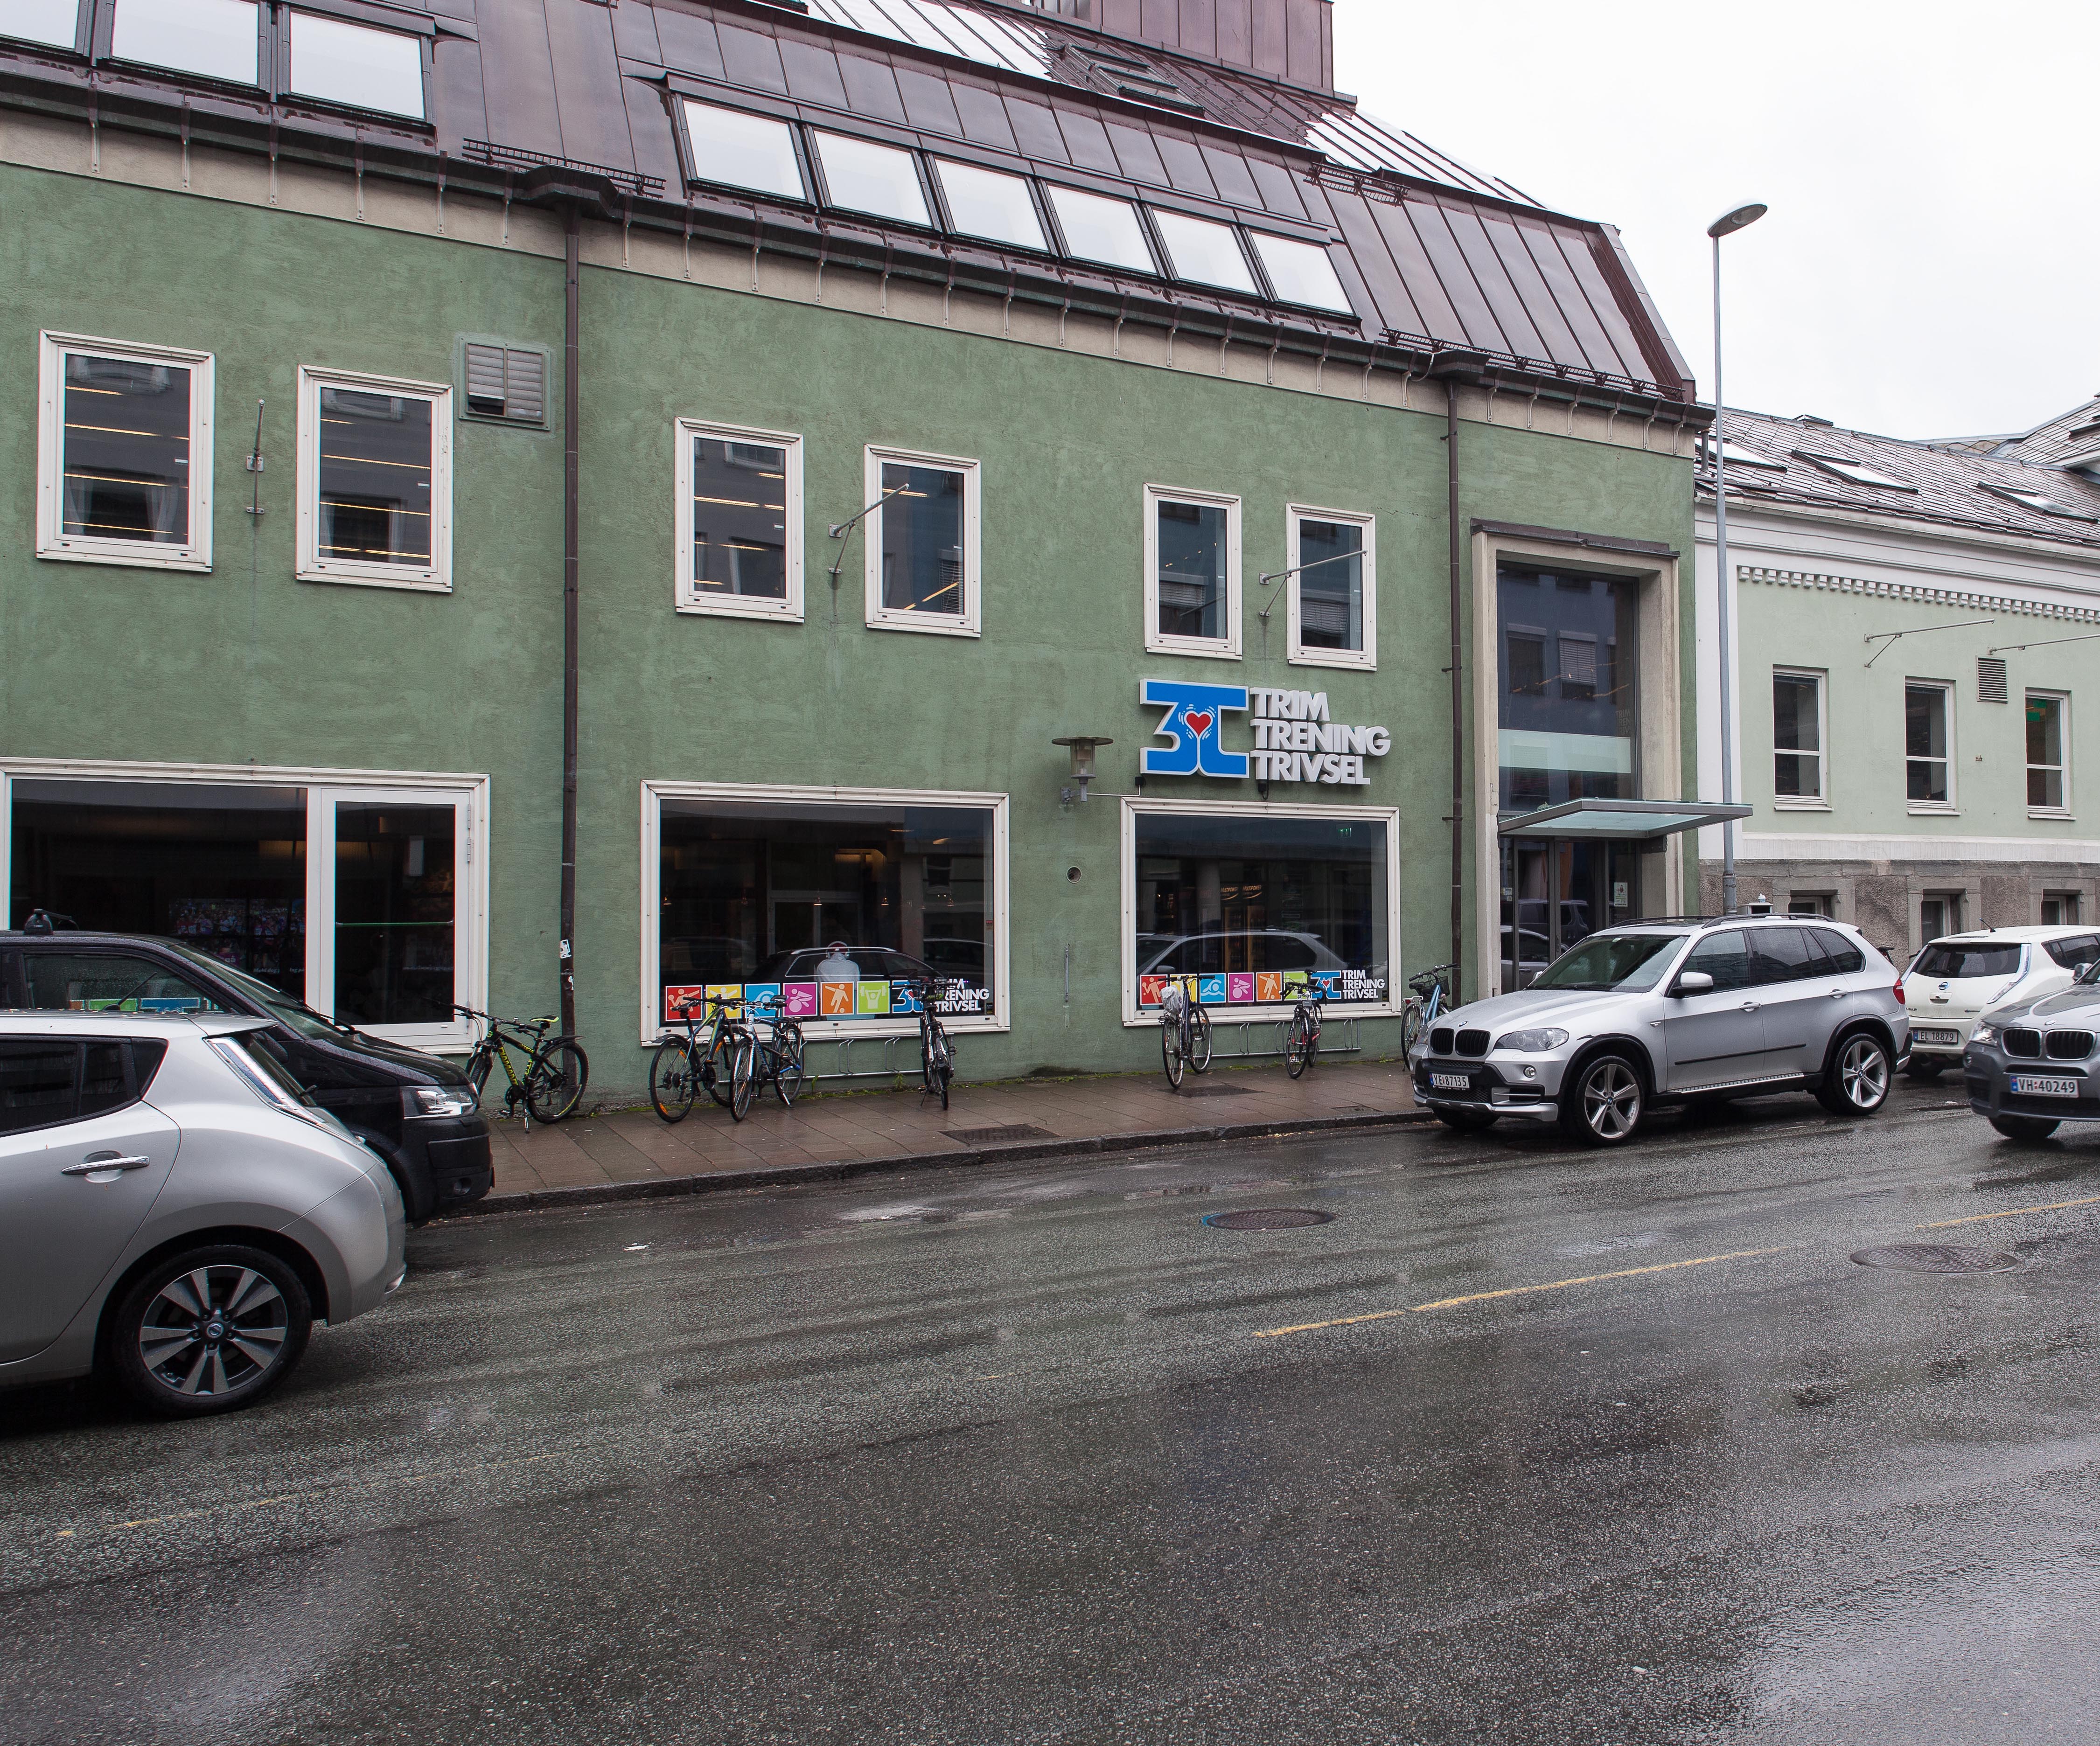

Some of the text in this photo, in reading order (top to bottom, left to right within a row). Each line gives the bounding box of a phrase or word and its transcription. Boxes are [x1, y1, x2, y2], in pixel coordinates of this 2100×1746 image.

[1249, 687, 1330, 721] TRIM
[1250, 718, 1391, 756] TRENING
[1250, 750, 1370, 785] TRIVSEL
[1342, 970, 1366, 980] TRIM
[1342, 979, 1385, 989] TRENING
[1342, 988, 1379, 999] TRIVSEL
[935, 1000, 981, 1012] TRIVSEL
[1920, 1031, 1953, 1041] EL 18879
[1434, 1075, 1466, 1086] YE 87135
[2018, 1078, 2075, 1093] VH 40249
